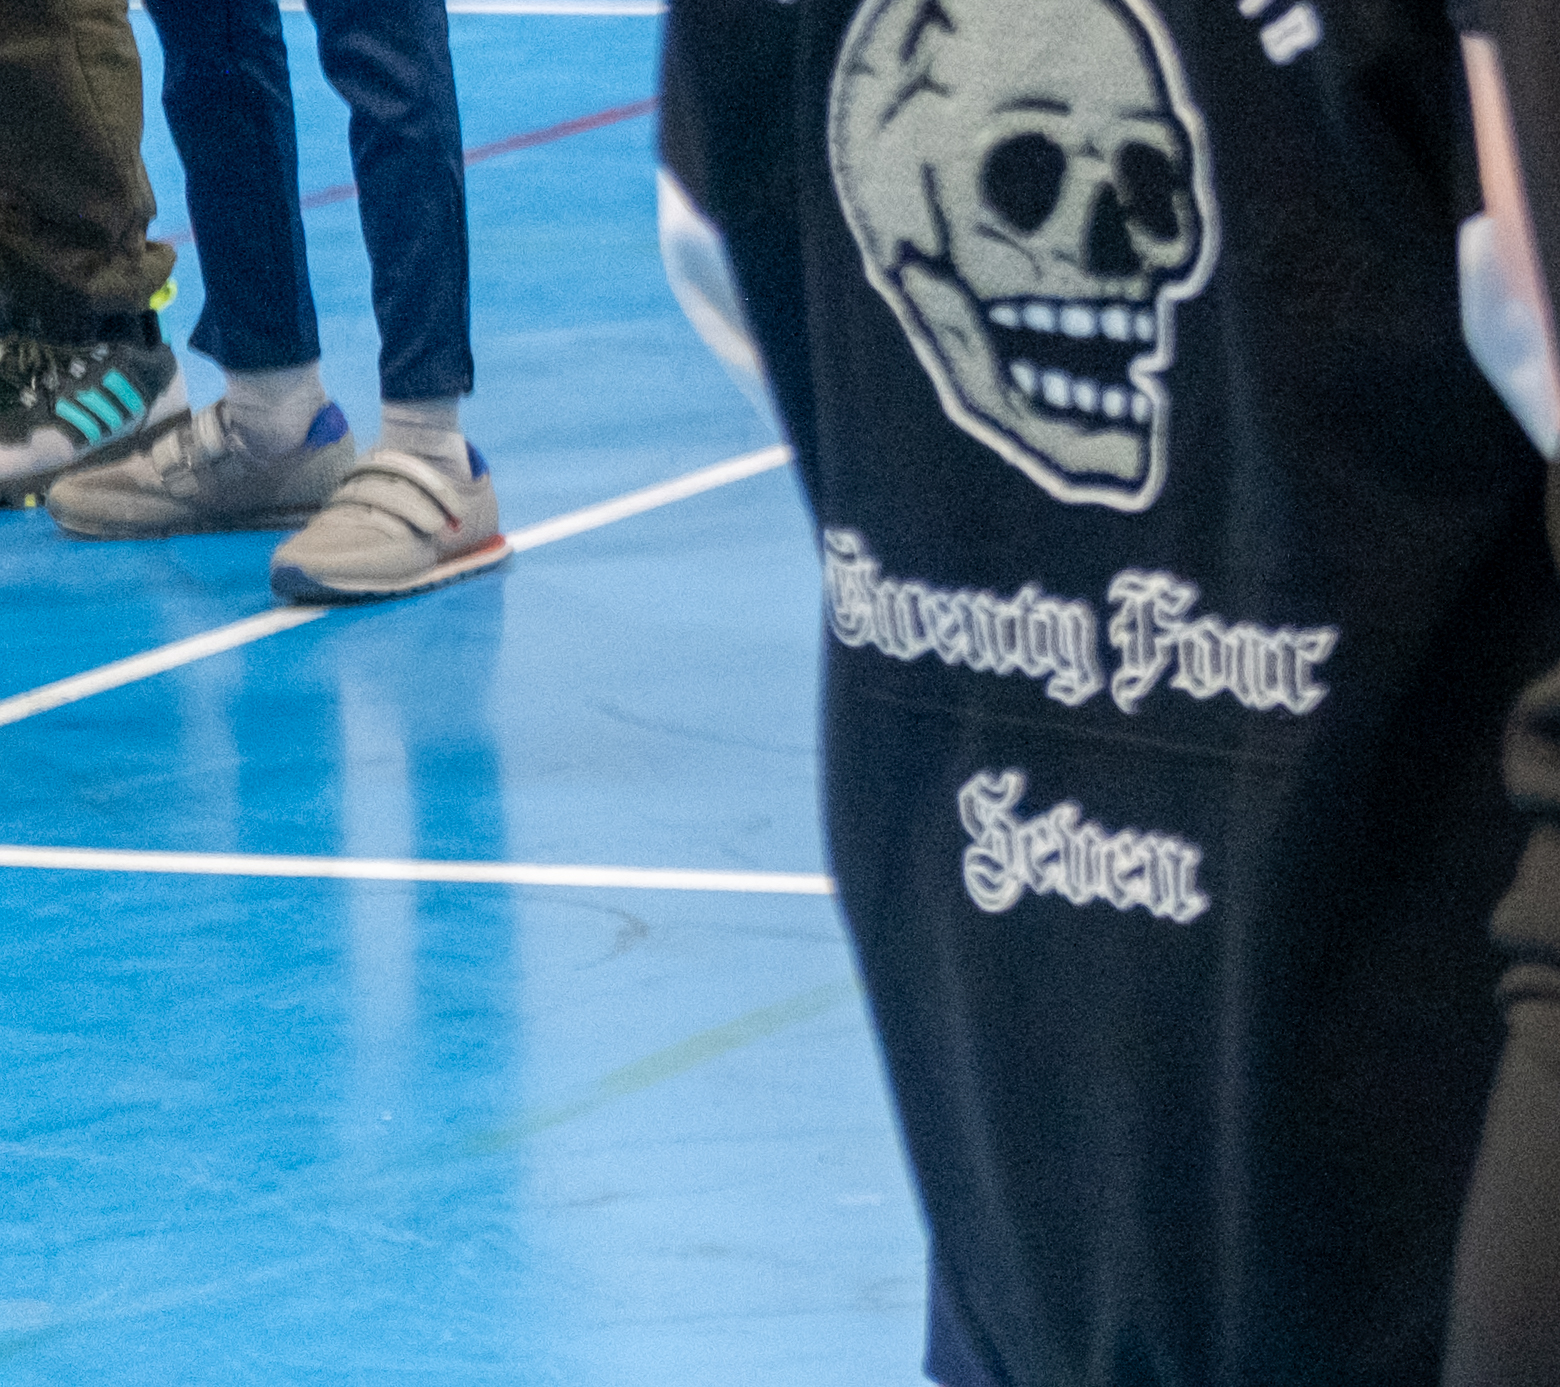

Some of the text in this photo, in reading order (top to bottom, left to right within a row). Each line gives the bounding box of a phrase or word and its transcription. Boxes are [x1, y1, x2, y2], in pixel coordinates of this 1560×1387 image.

[824, 528, 1339, 715] Twenty Four
[958, 770, 1209, 921] Seven
